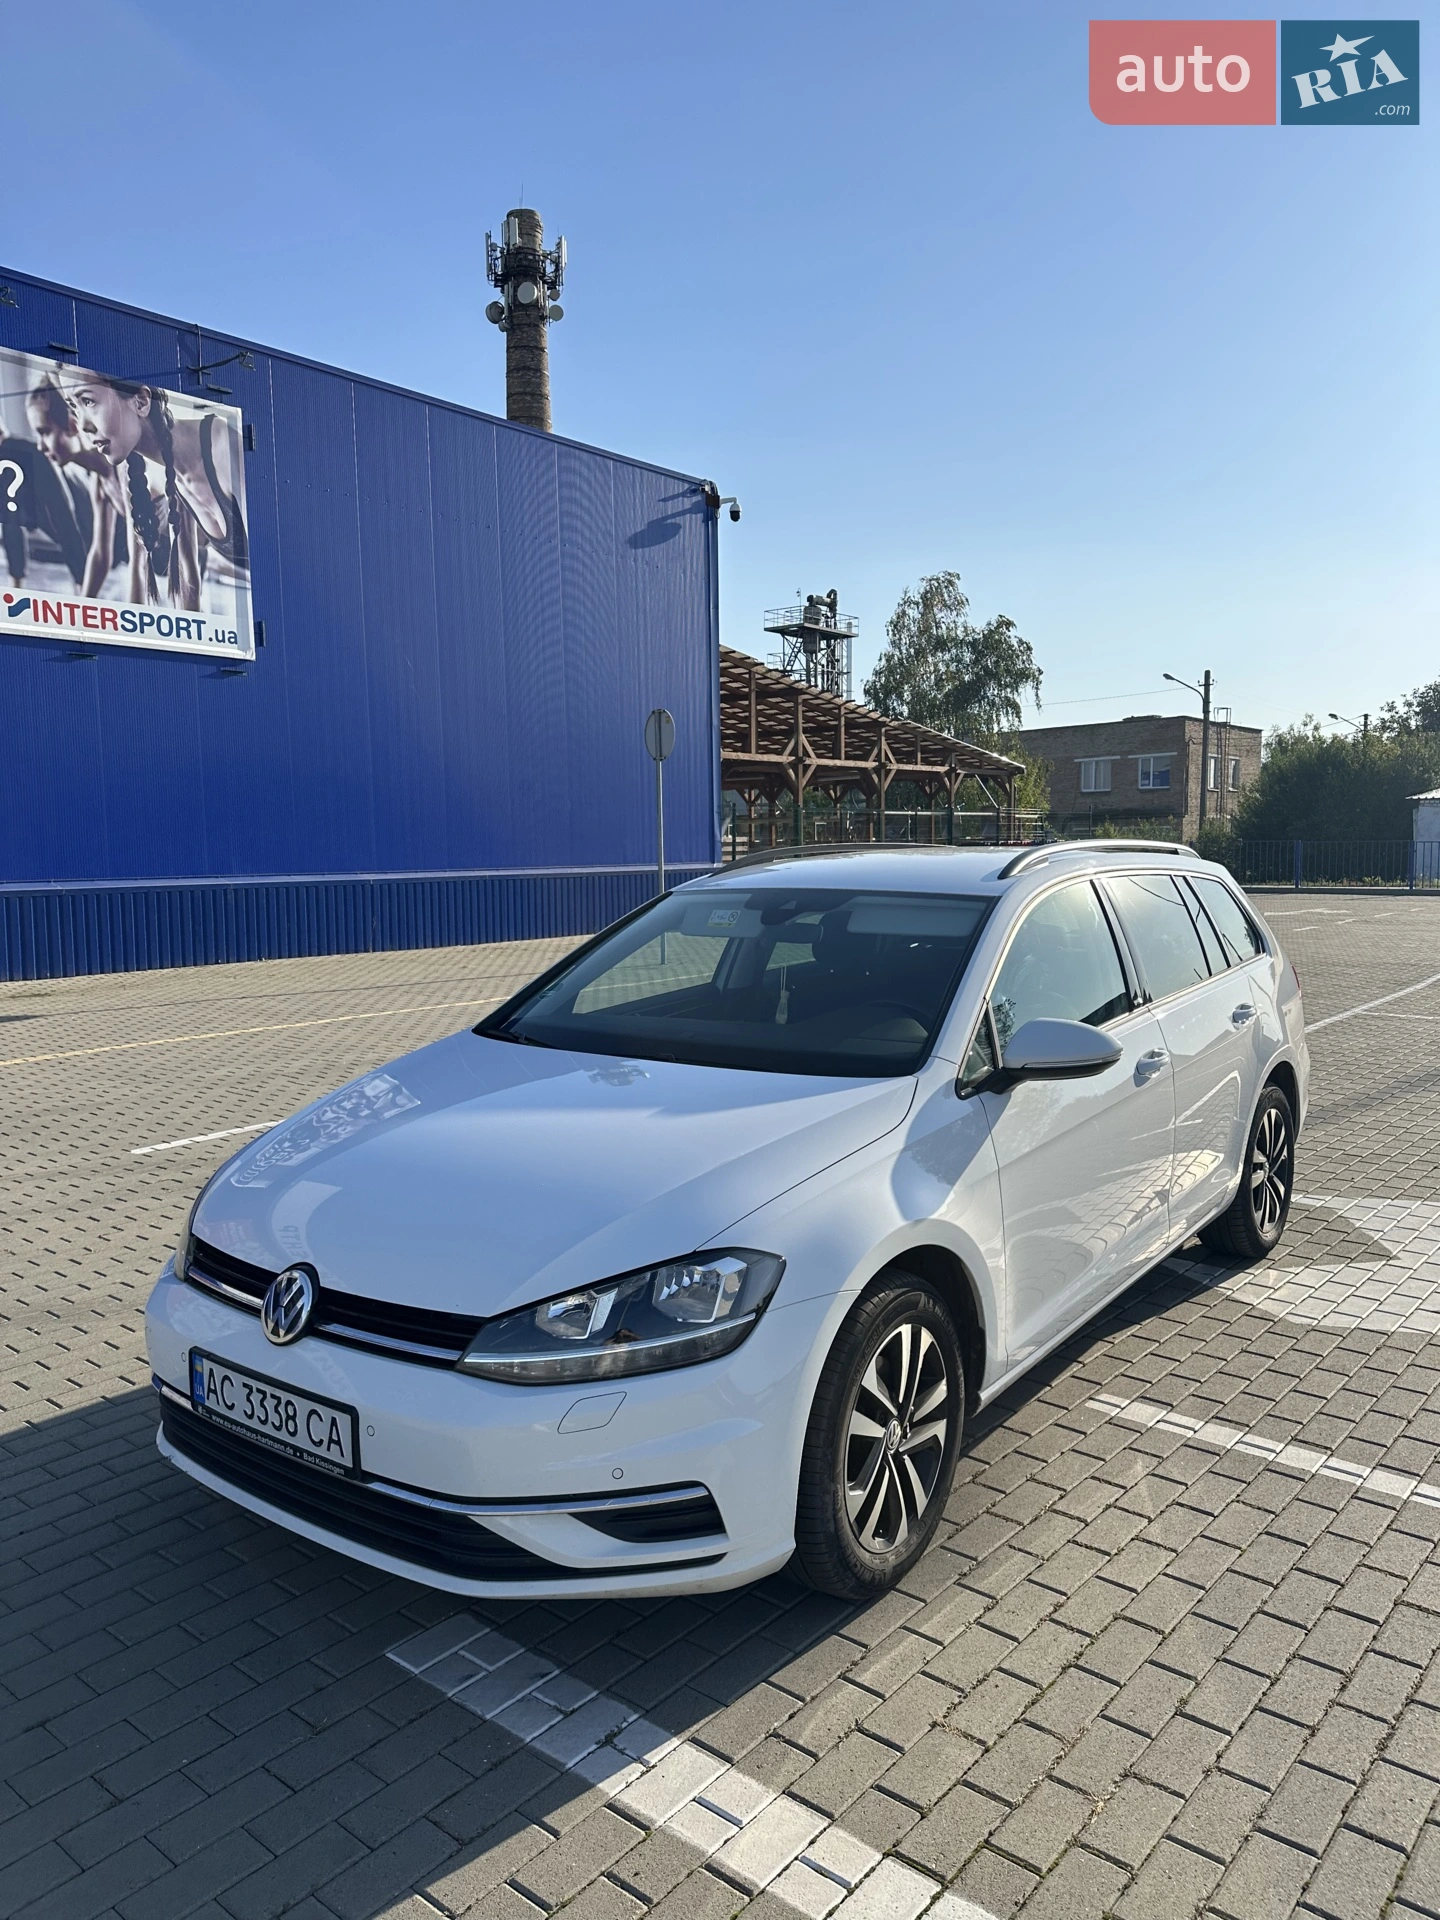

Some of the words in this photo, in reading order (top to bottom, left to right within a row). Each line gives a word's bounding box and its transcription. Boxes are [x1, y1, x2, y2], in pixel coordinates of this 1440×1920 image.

[195, 1382, 205, 1398] UA
[206, 1367, 236, 1411] AC
[241, 1381, 299, 1438] 3338
[306, 1408, 346, 1458] CA
[303, 1452, 315, 1464] Bad
